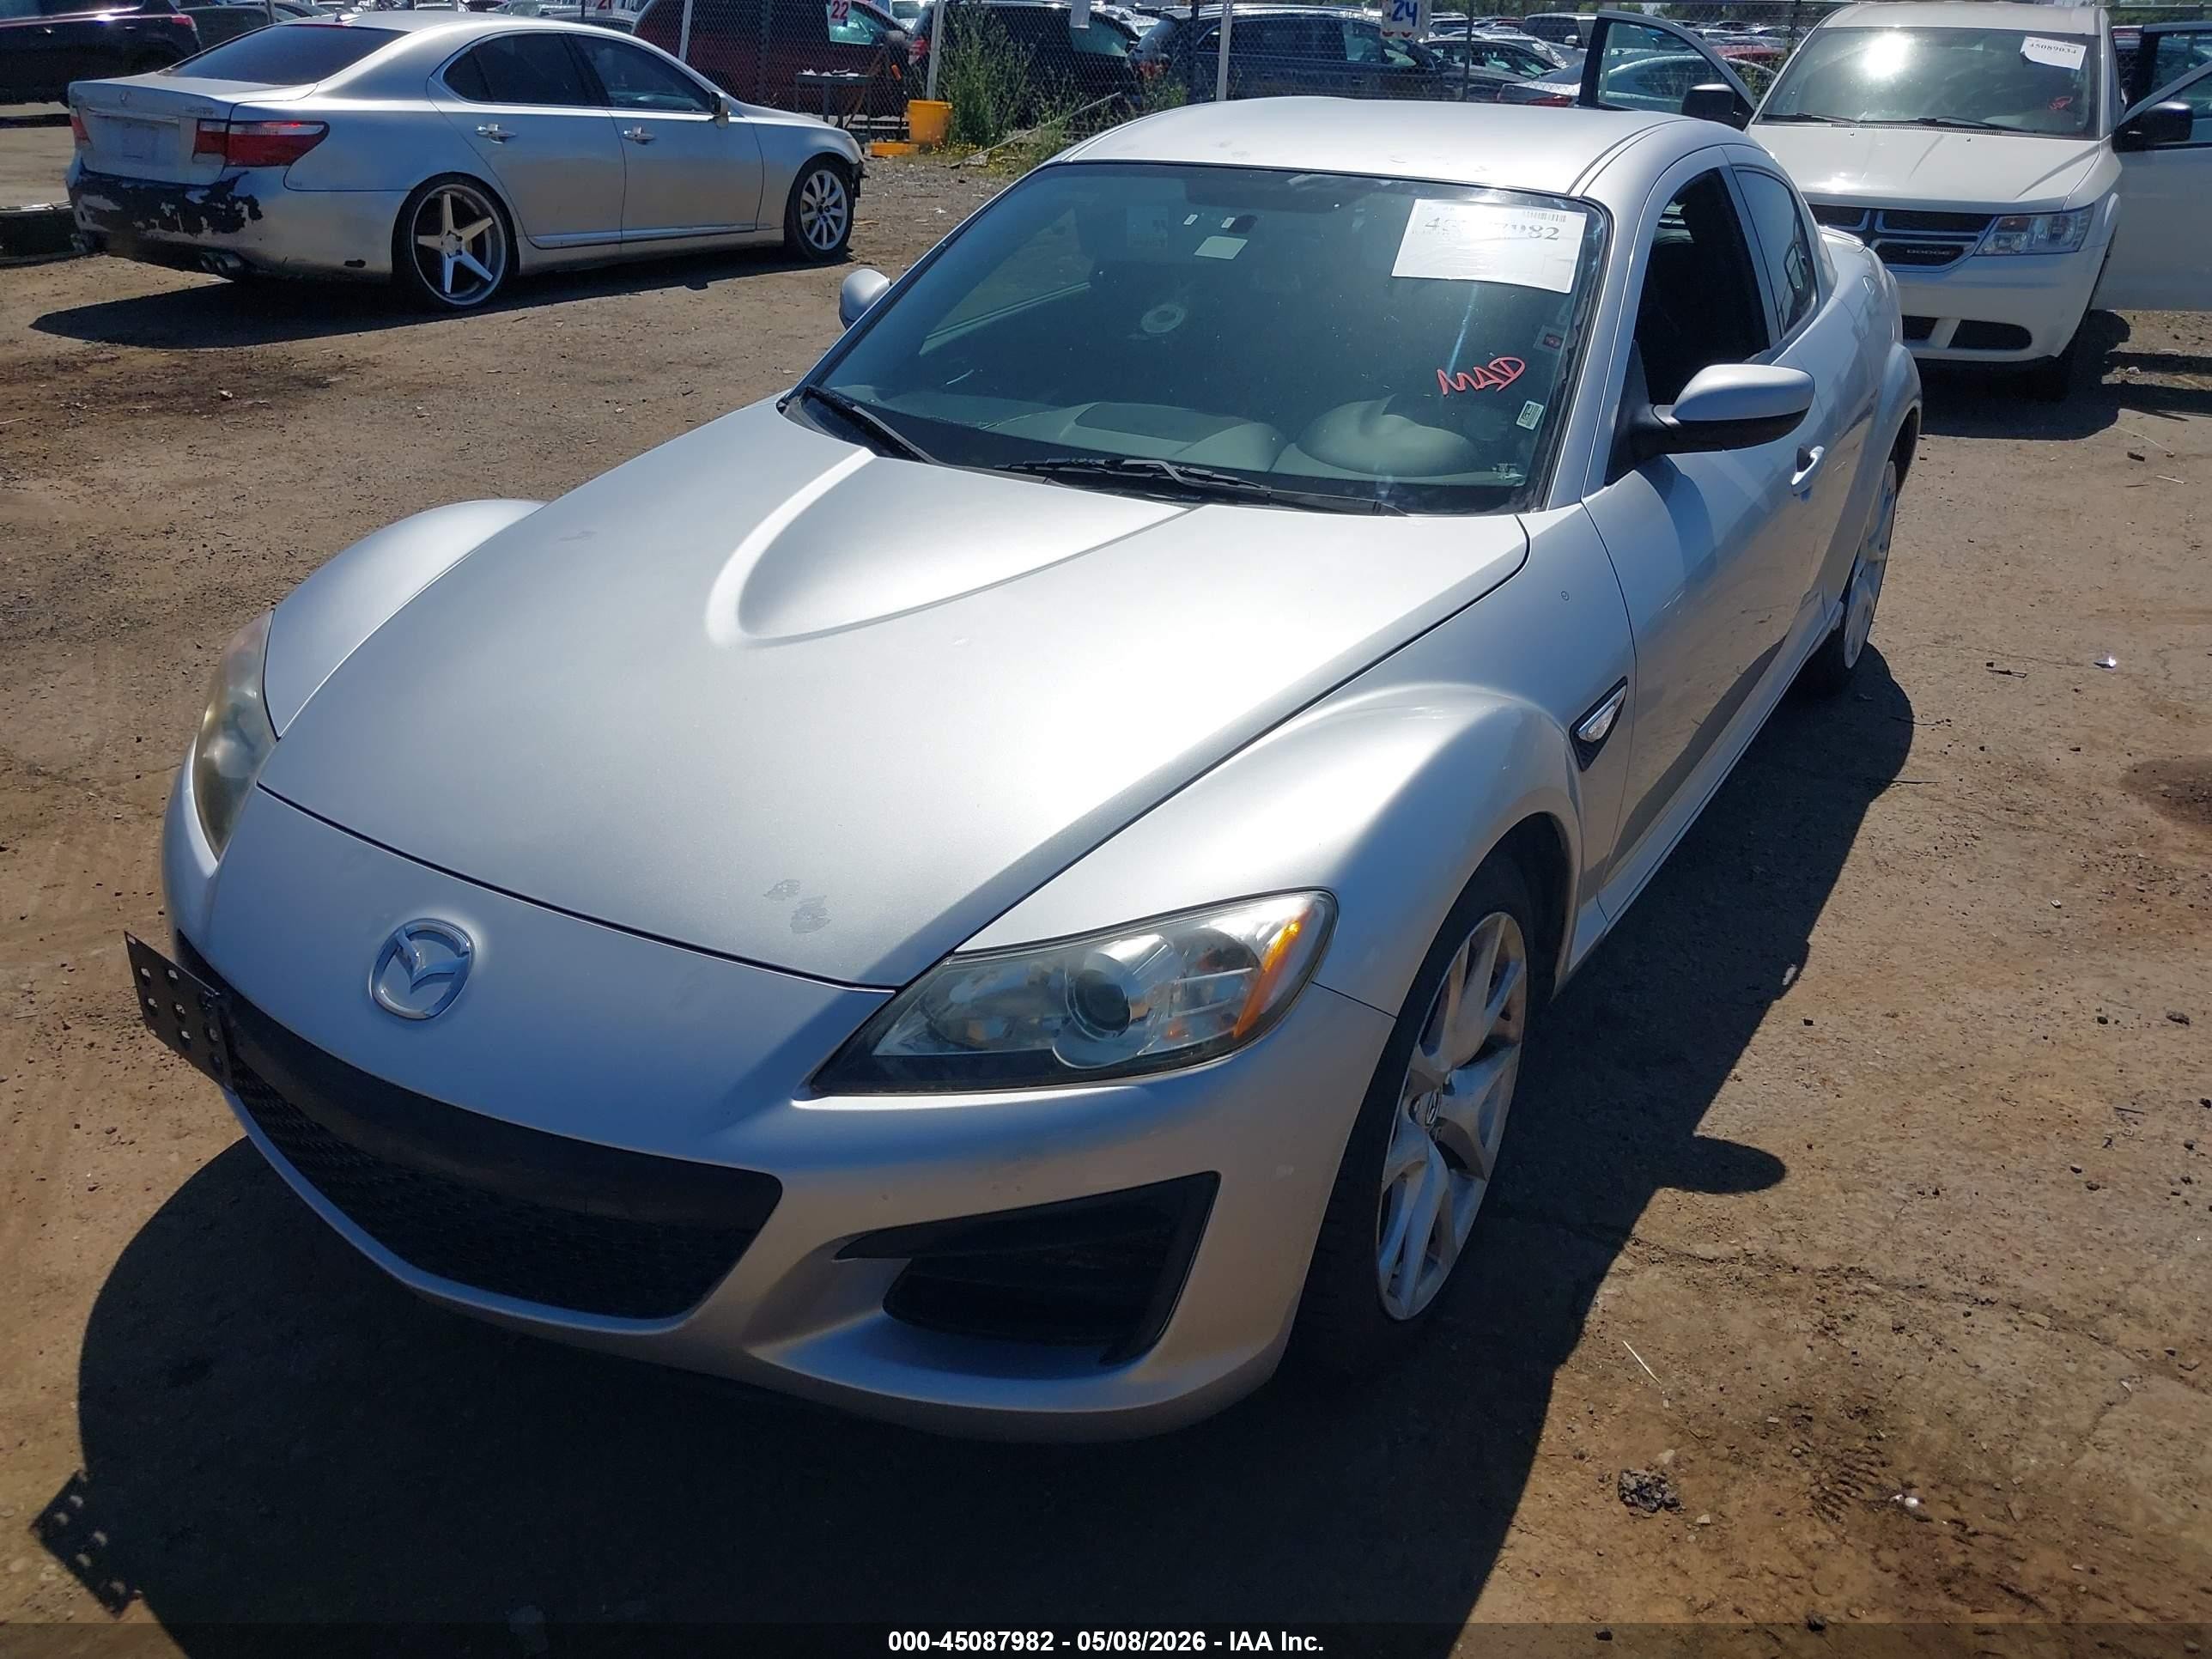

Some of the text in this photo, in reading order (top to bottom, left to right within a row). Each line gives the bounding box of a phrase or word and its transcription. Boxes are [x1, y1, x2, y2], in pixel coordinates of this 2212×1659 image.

[831, 0, 848, 20] 22
[1391, 0, 1418, 27] 24
[1437, 356, 1526, 395] MAD
